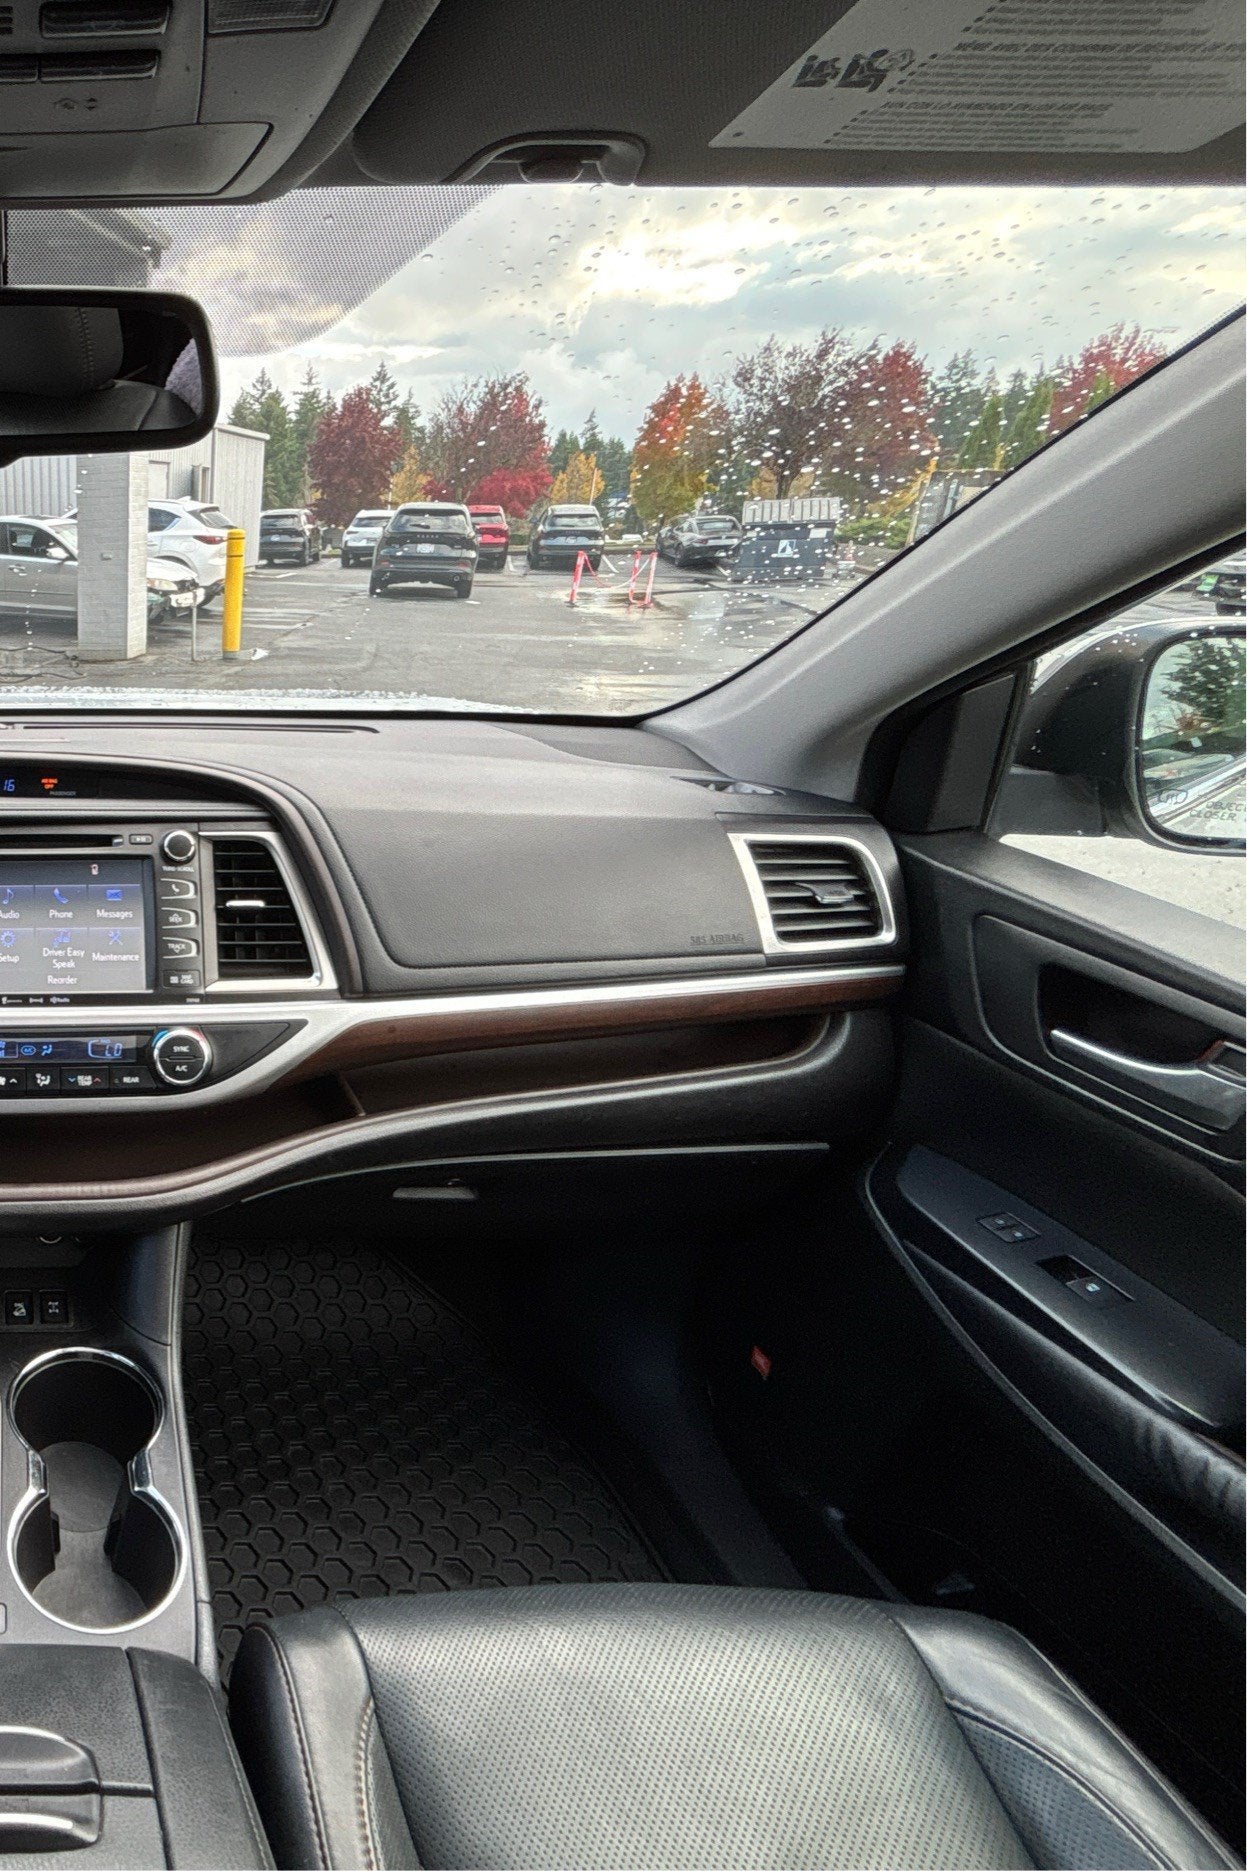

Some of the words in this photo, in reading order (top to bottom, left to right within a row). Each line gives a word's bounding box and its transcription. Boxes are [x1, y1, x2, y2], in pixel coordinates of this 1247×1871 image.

[49, 910, 73, 919] Phone
[96, 909, 133, 919] Messages
[710, 934, 744, 944] AIRBAG
[43, 948, 66, 957] Driver
[67, 948, 85, 958] Easy
[92, 952, 140, 962] Maintenance
[53, 960, 75, 969] Speak
[47, 975, 78, 984] Reorder
